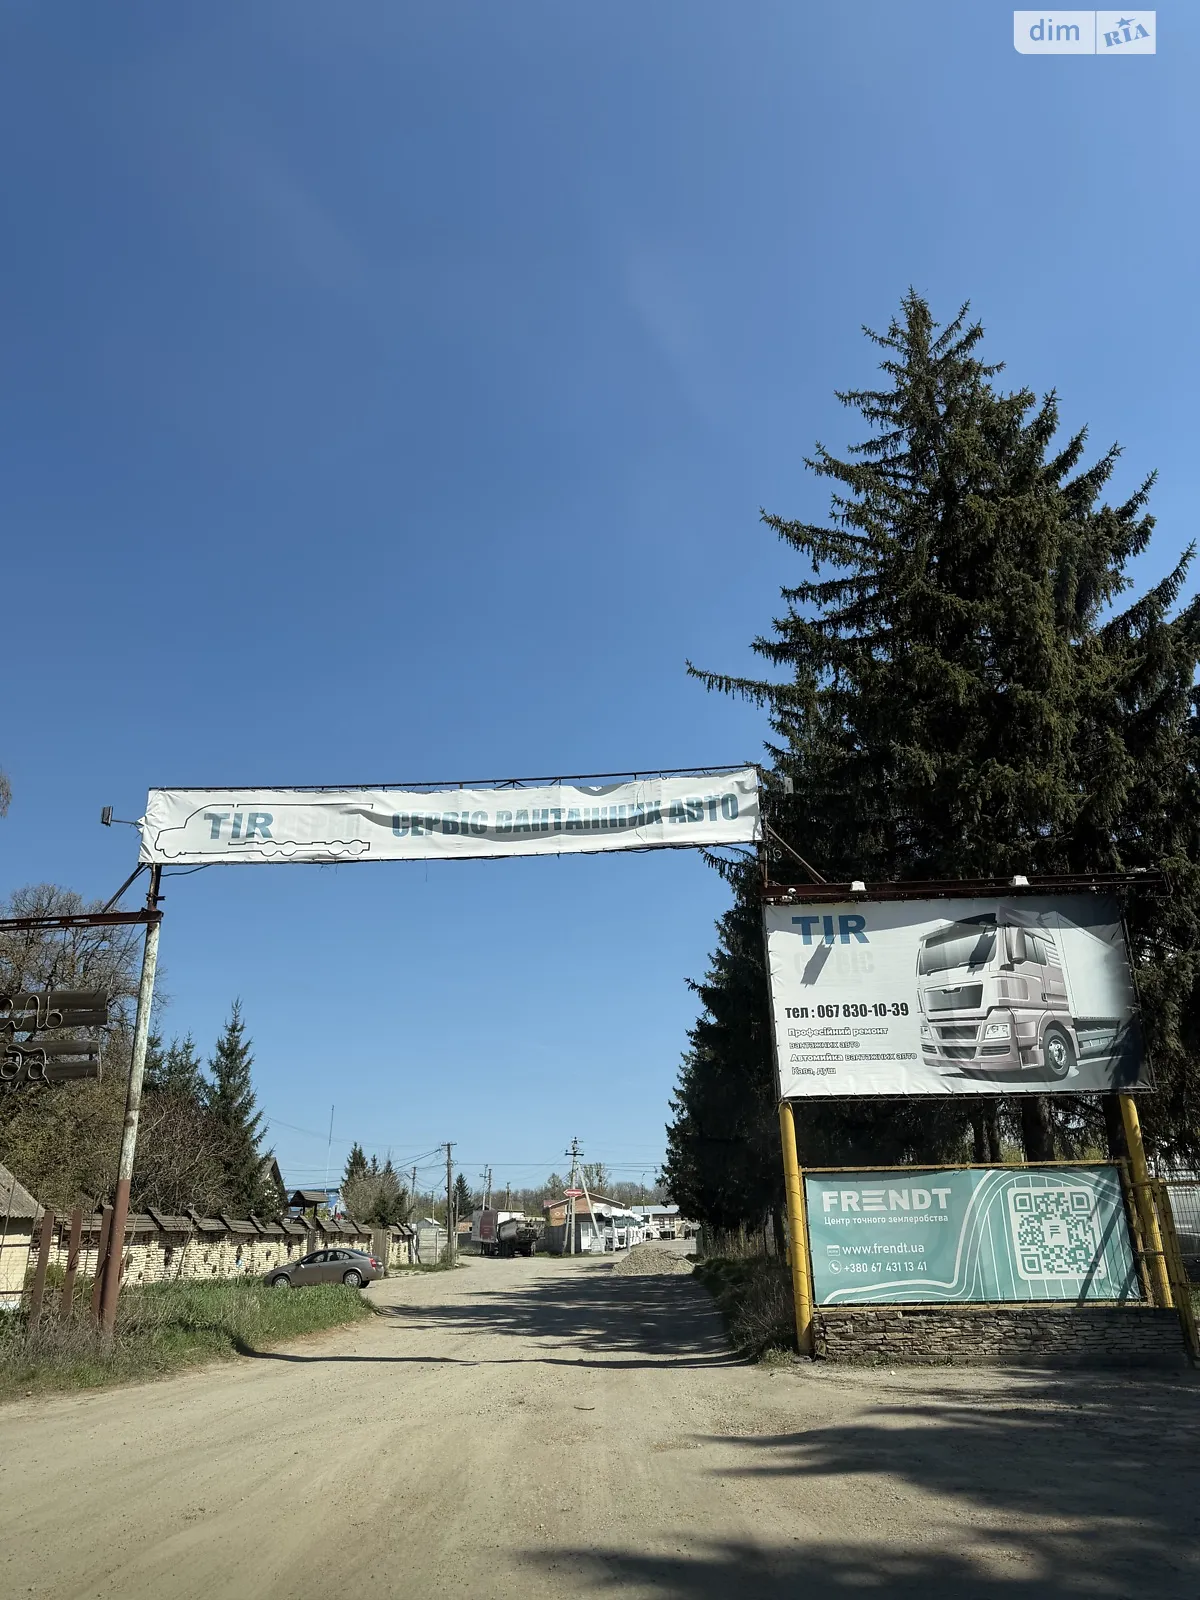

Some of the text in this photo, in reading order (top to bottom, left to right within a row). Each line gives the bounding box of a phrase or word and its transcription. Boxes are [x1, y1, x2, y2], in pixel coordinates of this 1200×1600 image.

[391, 810, 488, 838] СЕРВІС
[668, 792, 739, 824] АВТО
[203, 811, 274, 840] TIR
[791, 914, 870, 946] TIR
[816, 1004, 840, 1018] 067
[842, 1002, 909, 1018] 830-10-39
[787, 1027, 889, 1037] Професійний ремонт
[789, 1041, 861, 1049] вантажних авто
[790, 1052, 918, 1062] Автомийка вантажних авто
[822, 1188, 951, 1212] FRENDT
[824, 1214, 948, 1226] Центр точного землеробства
[842, 1243, 925, 1255] www.frendt.ua
[844, 1261, 927, 1273] +380 67 431 13 41
